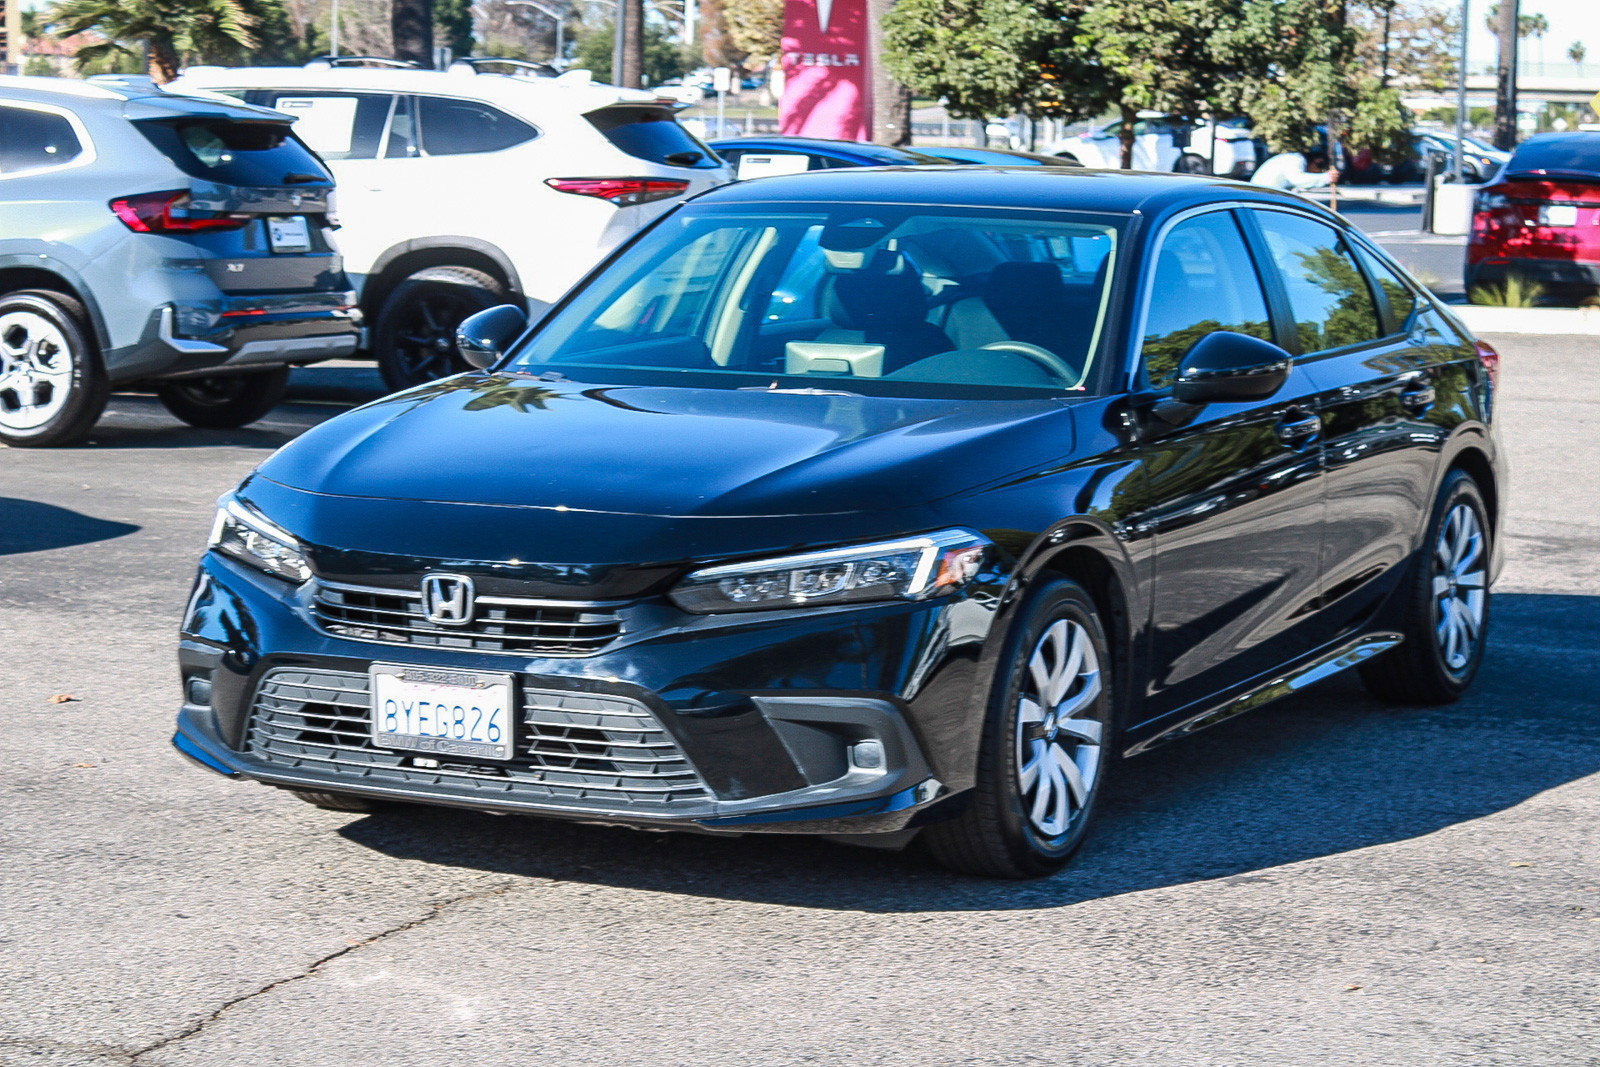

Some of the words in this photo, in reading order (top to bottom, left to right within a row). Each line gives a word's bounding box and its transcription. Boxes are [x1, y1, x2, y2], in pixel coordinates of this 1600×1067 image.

[785, 52, 860, 67] TESLA
[385, 699, 501, 743] 8YEG826
[379, 734, 417, 749] BMW
[420, 740, 436, 751] of
